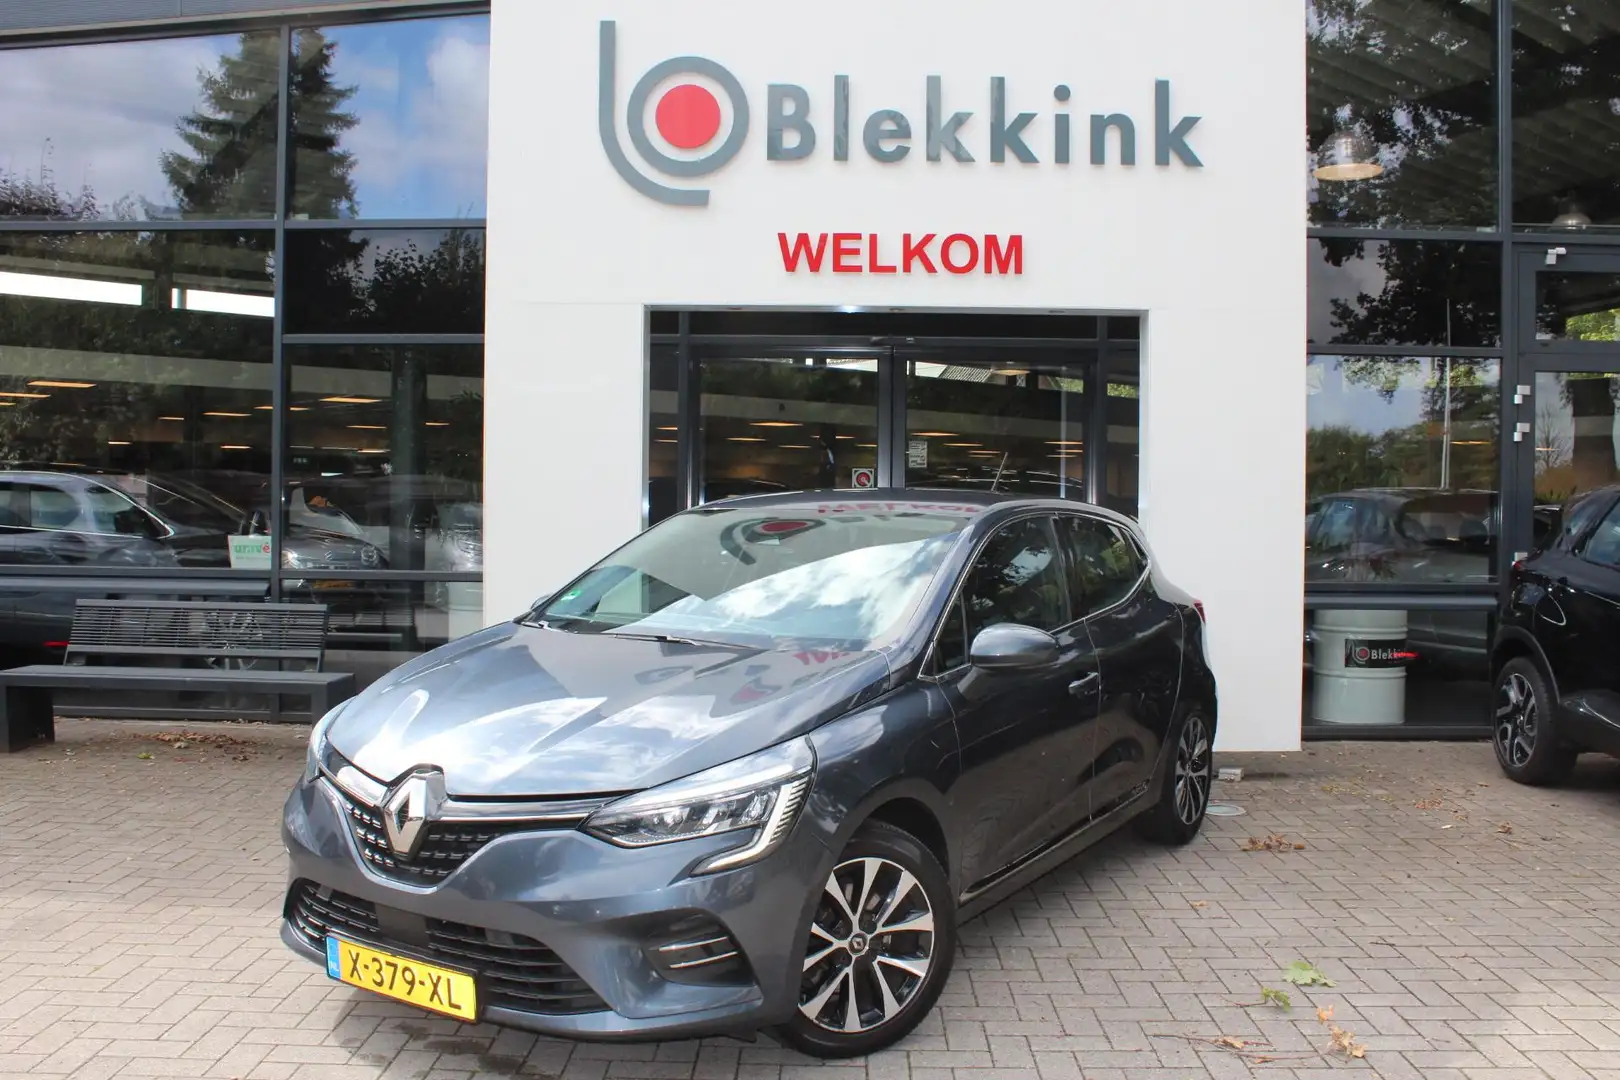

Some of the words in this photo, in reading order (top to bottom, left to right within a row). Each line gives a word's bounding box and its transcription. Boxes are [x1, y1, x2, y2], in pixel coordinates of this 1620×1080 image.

[766, 75, 1204, 168] Blekkink
[777, 232, 1024, 275] WELKOM
[348, 949, 462, 1010] X-379-XL
